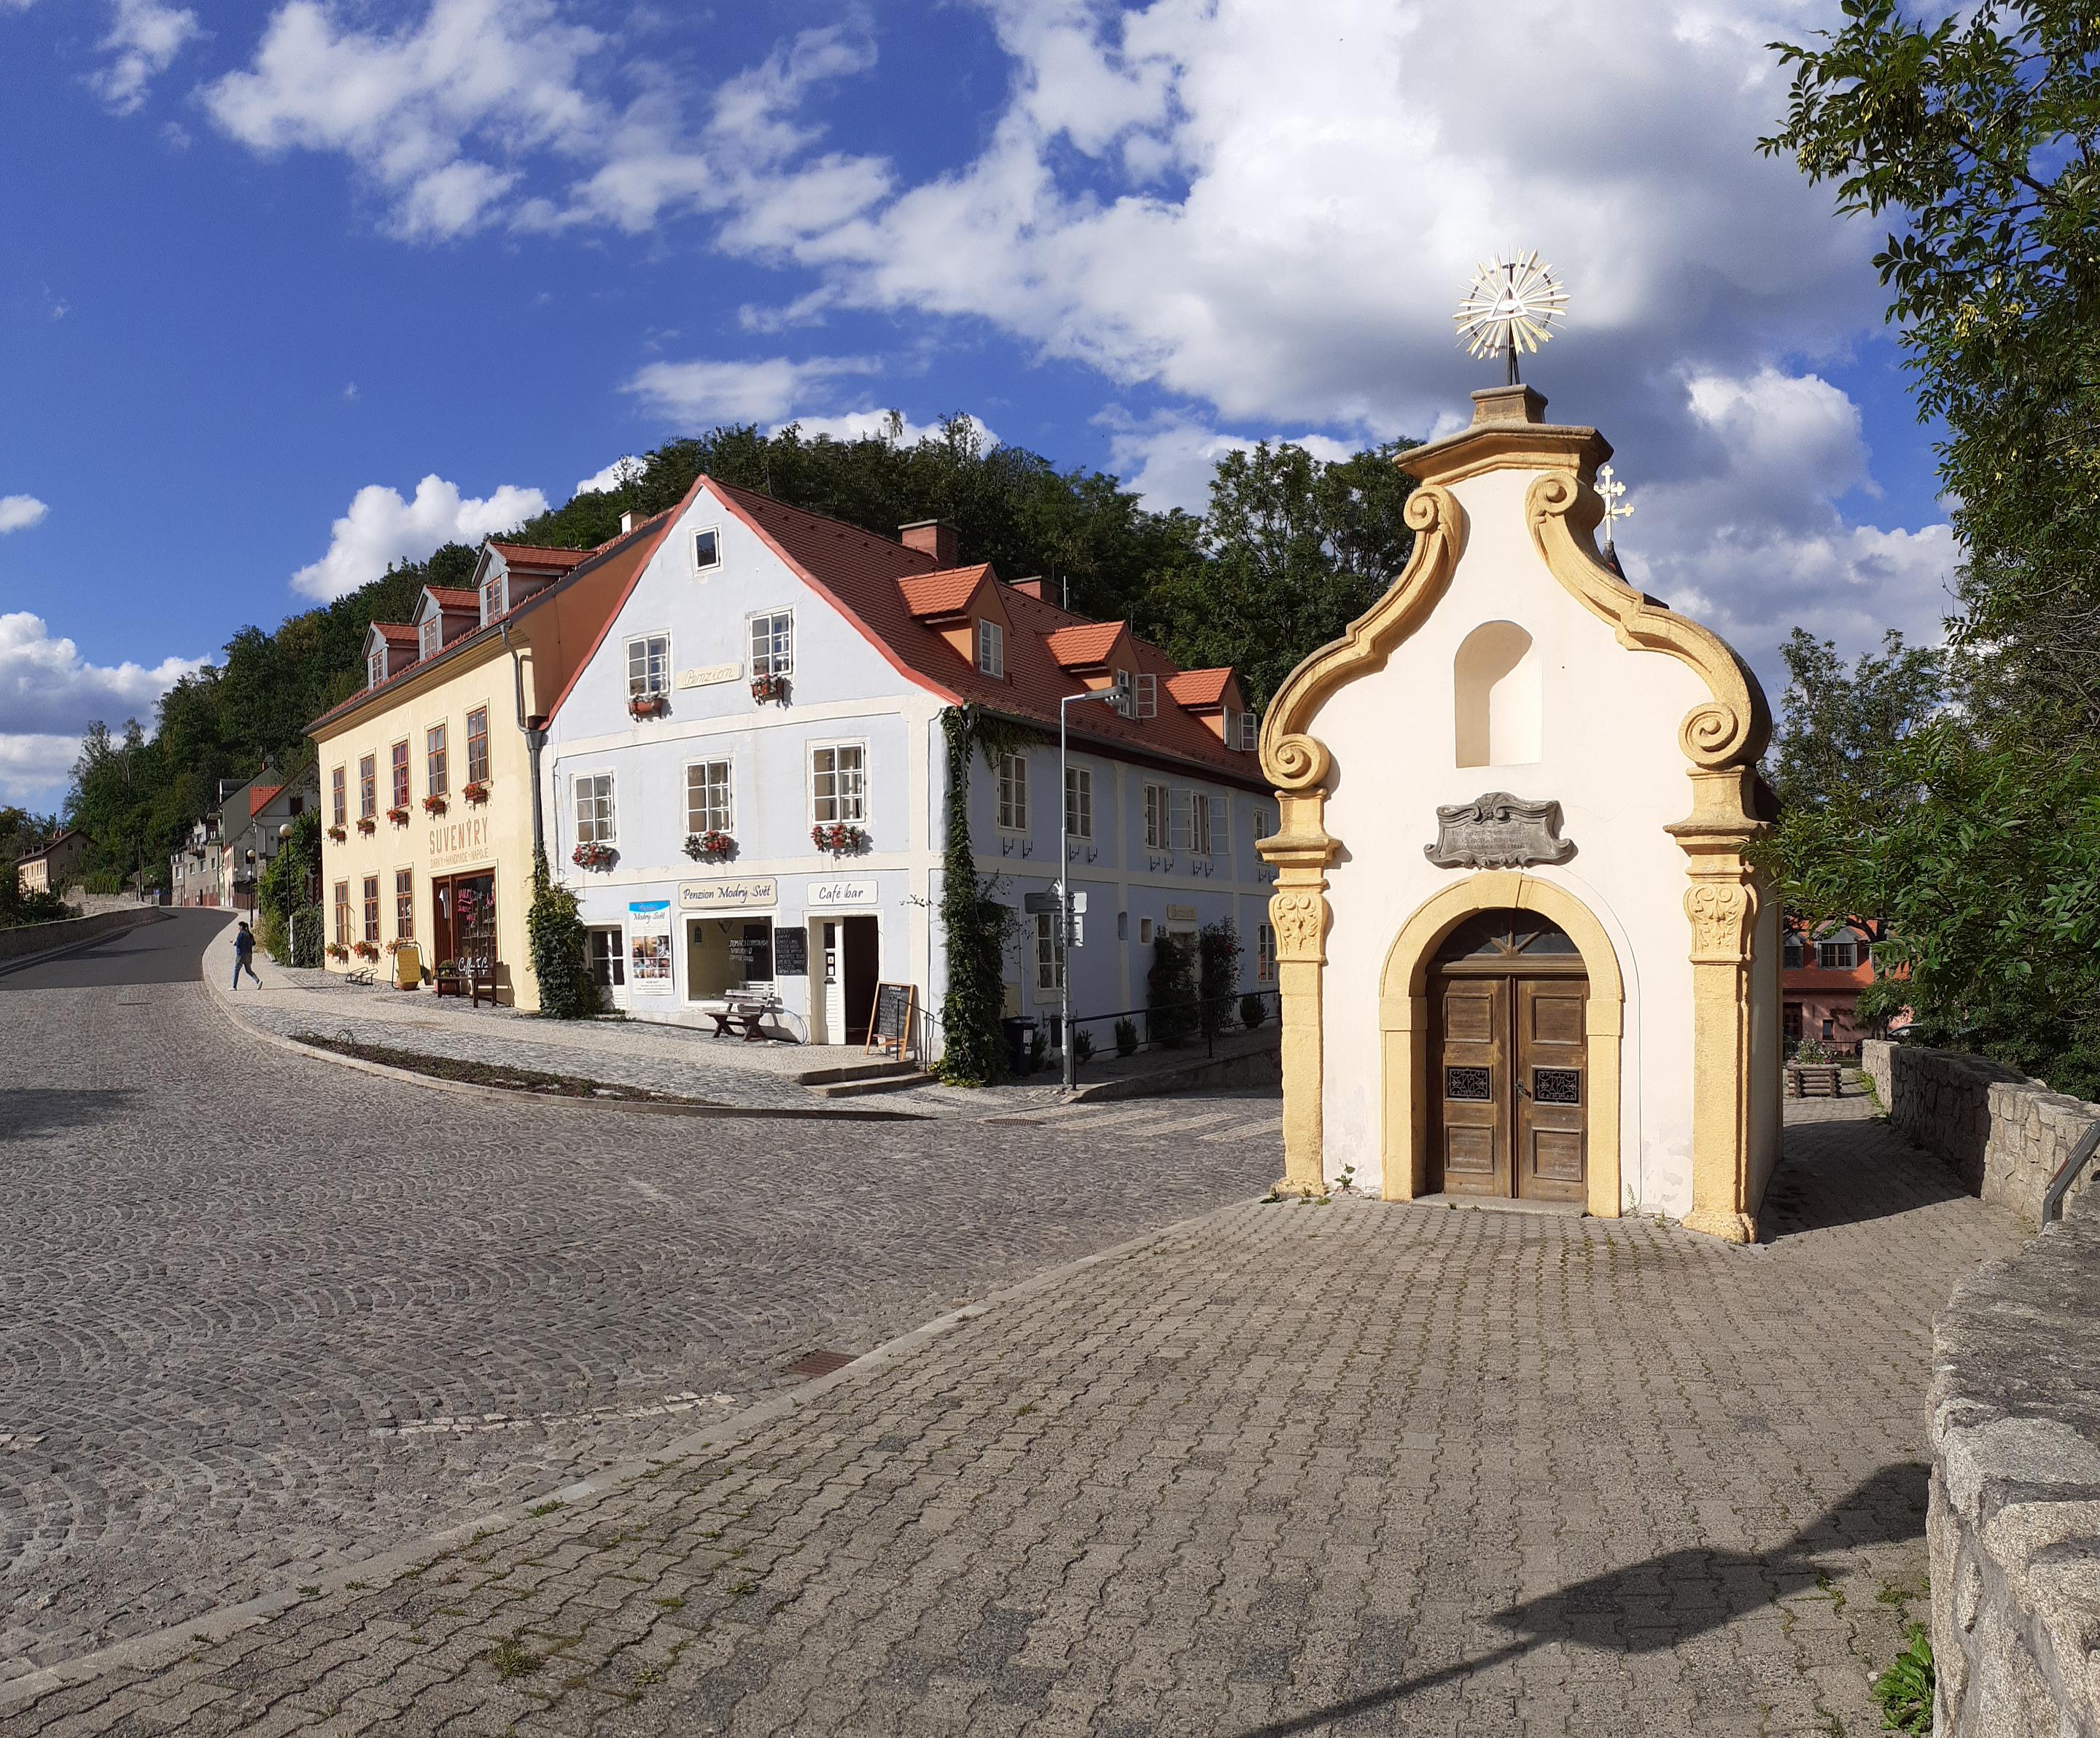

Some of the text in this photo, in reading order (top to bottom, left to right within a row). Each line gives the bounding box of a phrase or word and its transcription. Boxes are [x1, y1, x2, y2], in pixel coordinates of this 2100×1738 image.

[685, 668, 734, 686] Penzion
[429, 817, 488, 854] SUVENÝRY
[682, 884, 771, 904] Penzion Modrý Svět
[819, 883, 863, 903] Café bar
